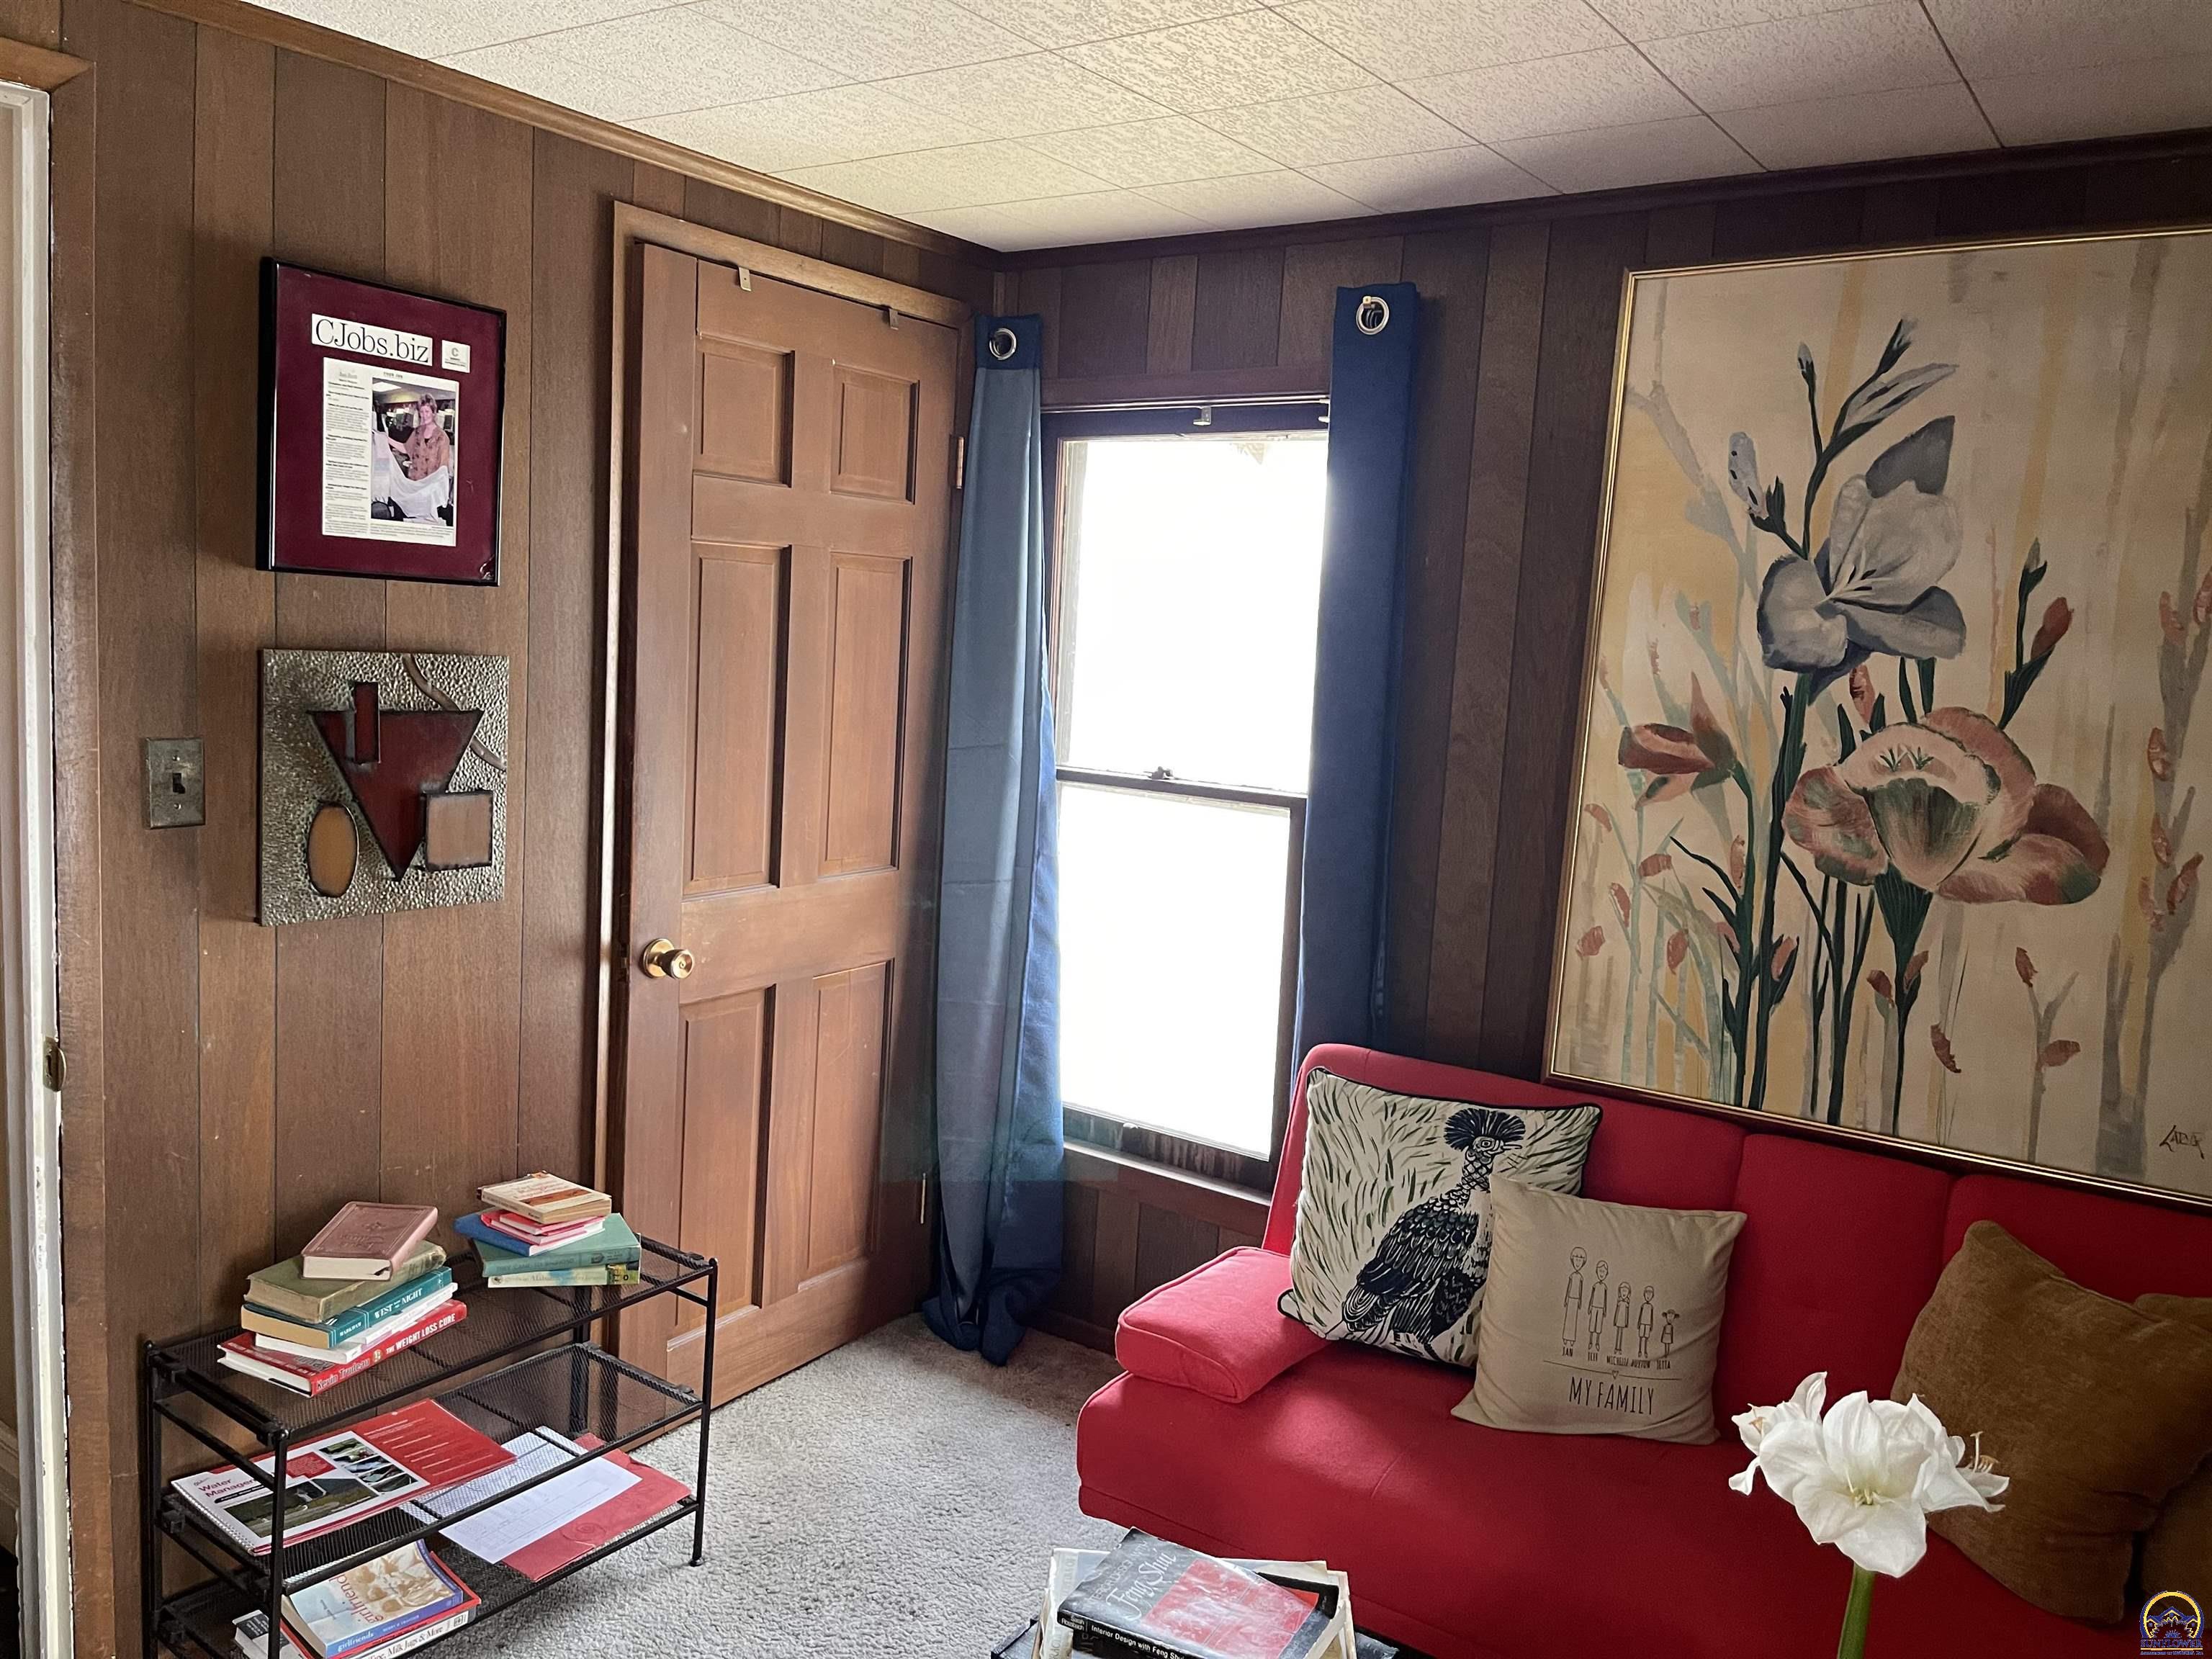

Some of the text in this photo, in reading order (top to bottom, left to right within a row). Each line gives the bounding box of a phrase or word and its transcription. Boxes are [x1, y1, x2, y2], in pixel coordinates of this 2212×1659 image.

[315, 318, 429, 364] CJobs.biz
[395, 1331, 421, 1350] WEIGHT
[421, 1323, 438, 1337] LOSS
[438, 1313, 456, 1328] CURE
[315, 1374, 338, 1391] Kevin
[1569, 1376, 1654, 1415] MY FAMILY
[198, 1478, 233, 1492] Water
[1105, 1580, 1155, 1620] Feng
[338, 1631, 374, 1653] girlfriends
[1092, 1625, 1114, 1637] Interior
[1115, 1632, 1137, 1647] Design
[1138, 1642, 1151, 1652] with
[1152, 1646, 1169, 1659] Feng
